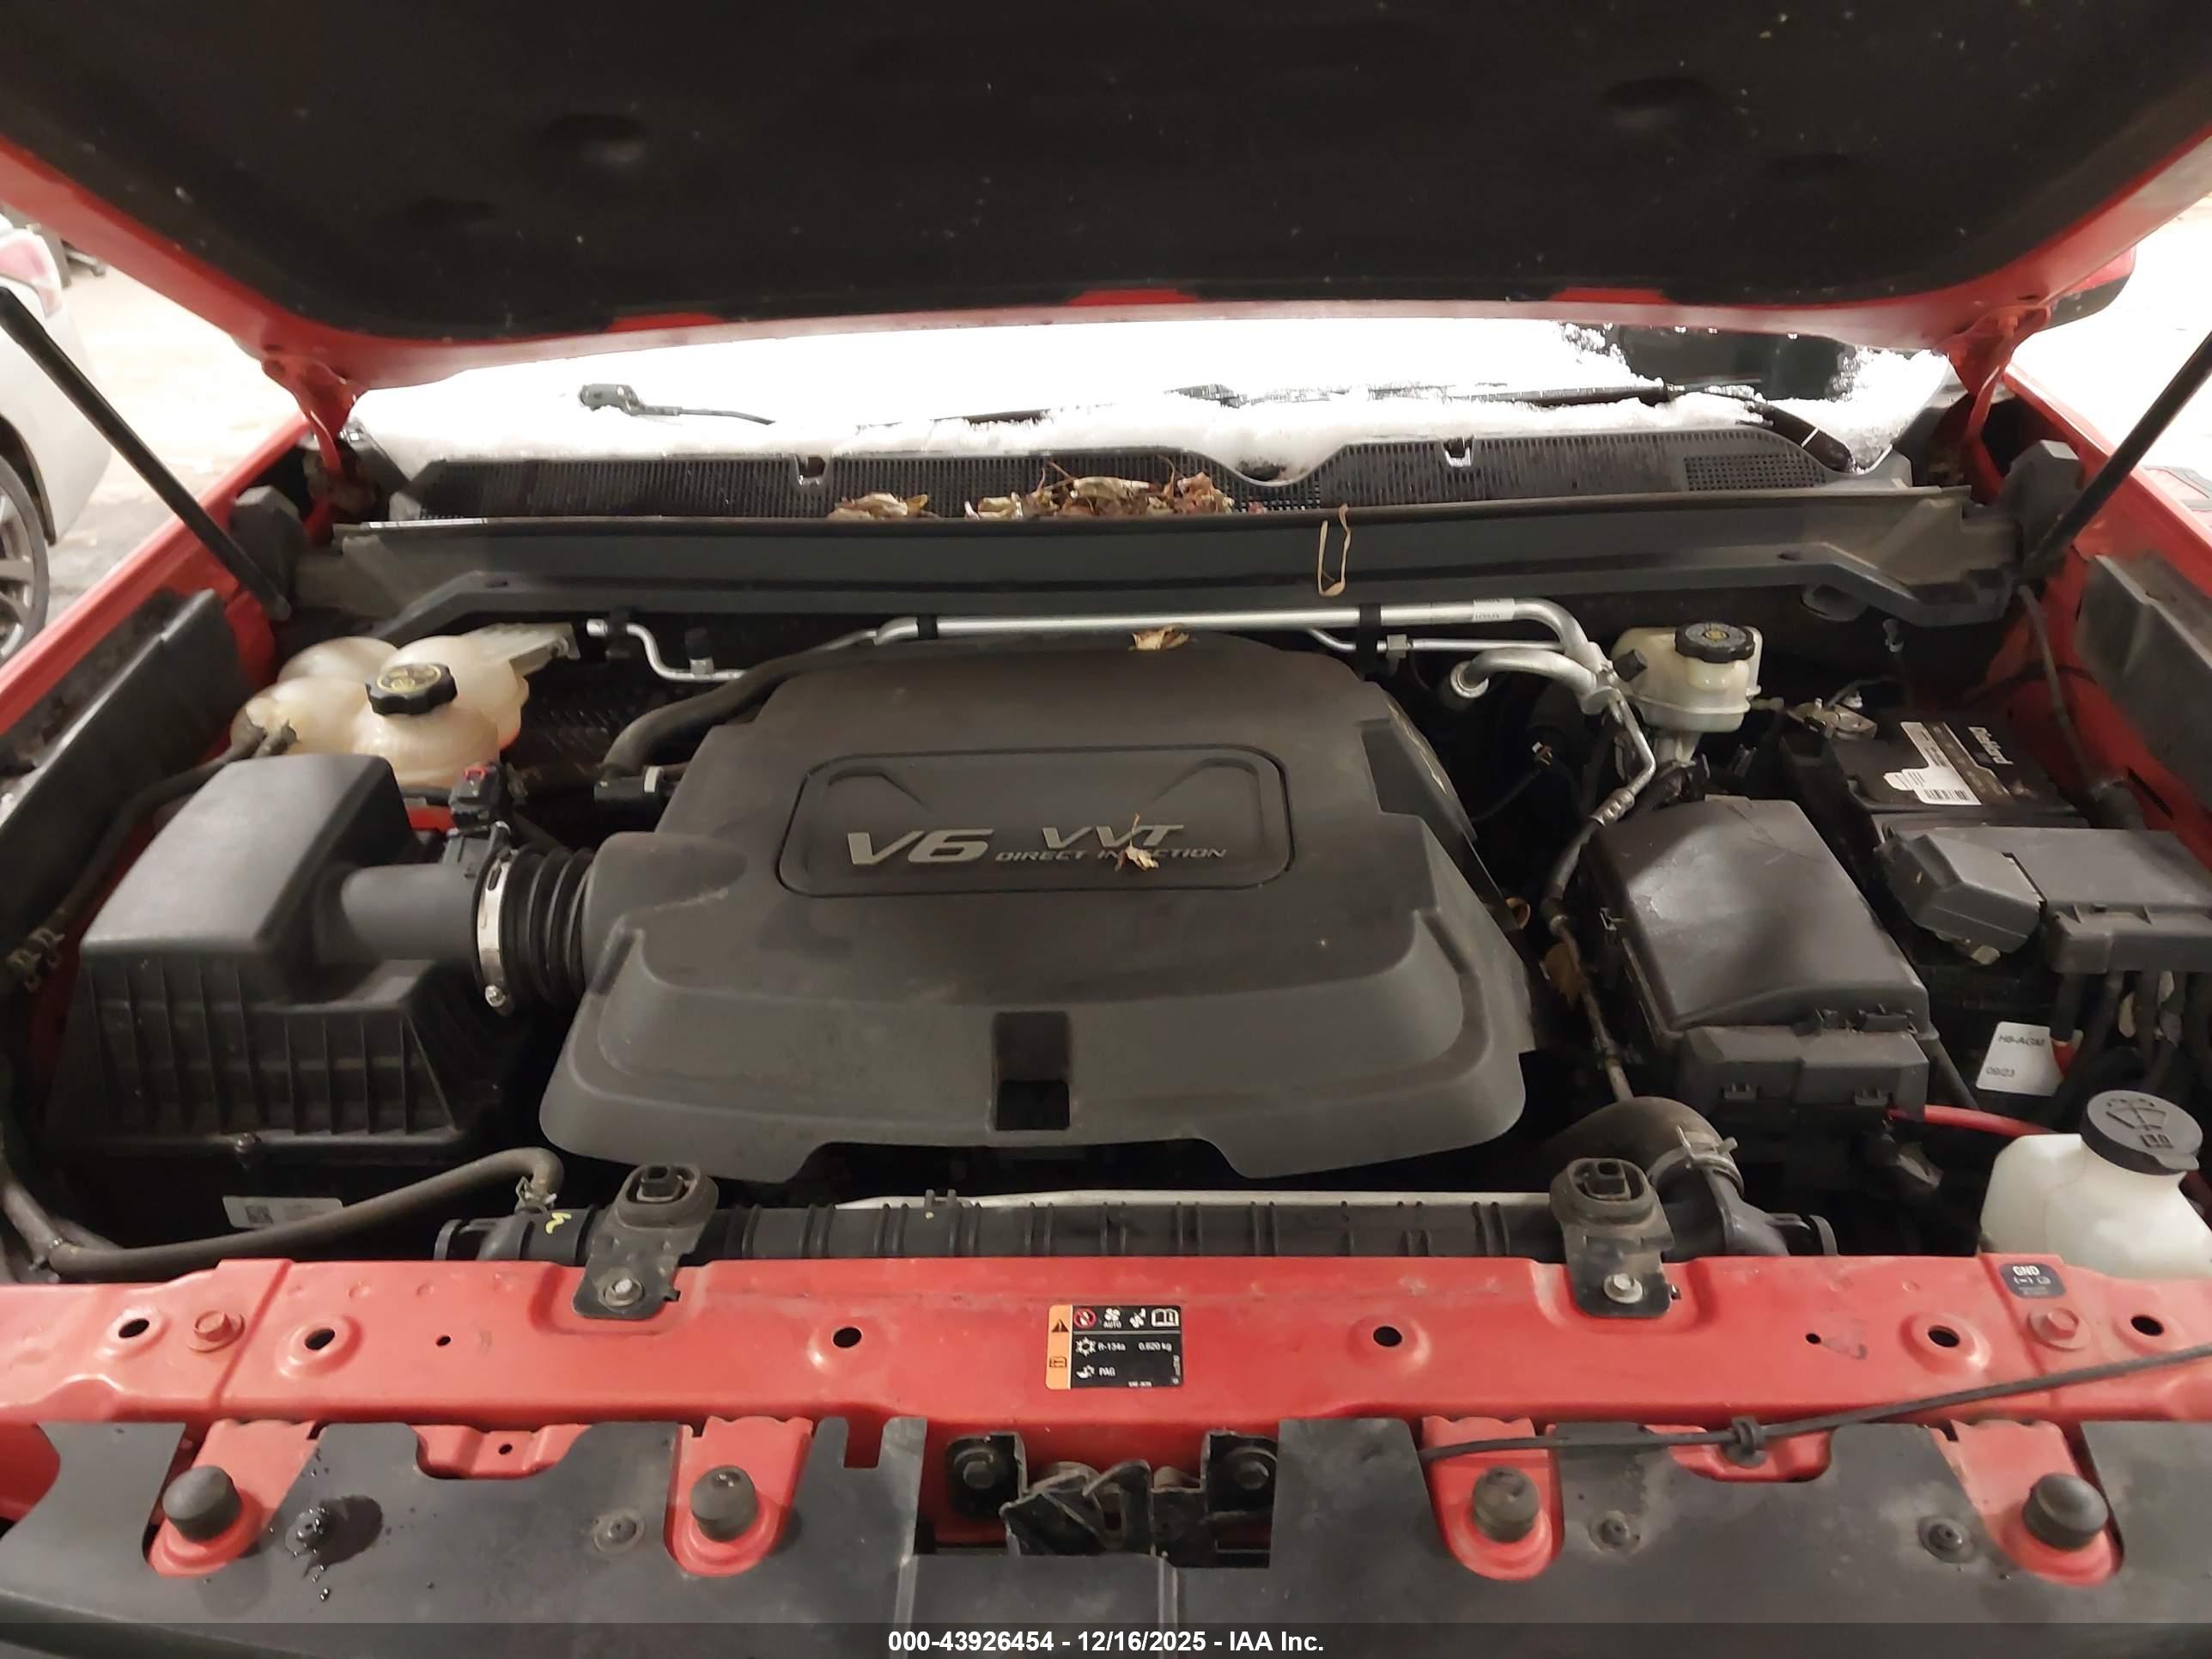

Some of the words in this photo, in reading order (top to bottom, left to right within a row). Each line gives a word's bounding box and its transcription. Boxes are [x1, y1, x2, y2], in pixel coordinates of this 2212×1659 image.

[848, 829, 994, 865] V6
[1042, 824, 1184, 849] VVT
[995, 850, 1088, 861] DIRECT
[1097, 848, 1226, 860] INCTION
[2013, 1265, 2040, 1276] GND
[1097, 1341, 1127, 1352] R-134a
[1162, 1342, 1172, 1352] kg
[1098, 1367, 1115, 1376] PAG
